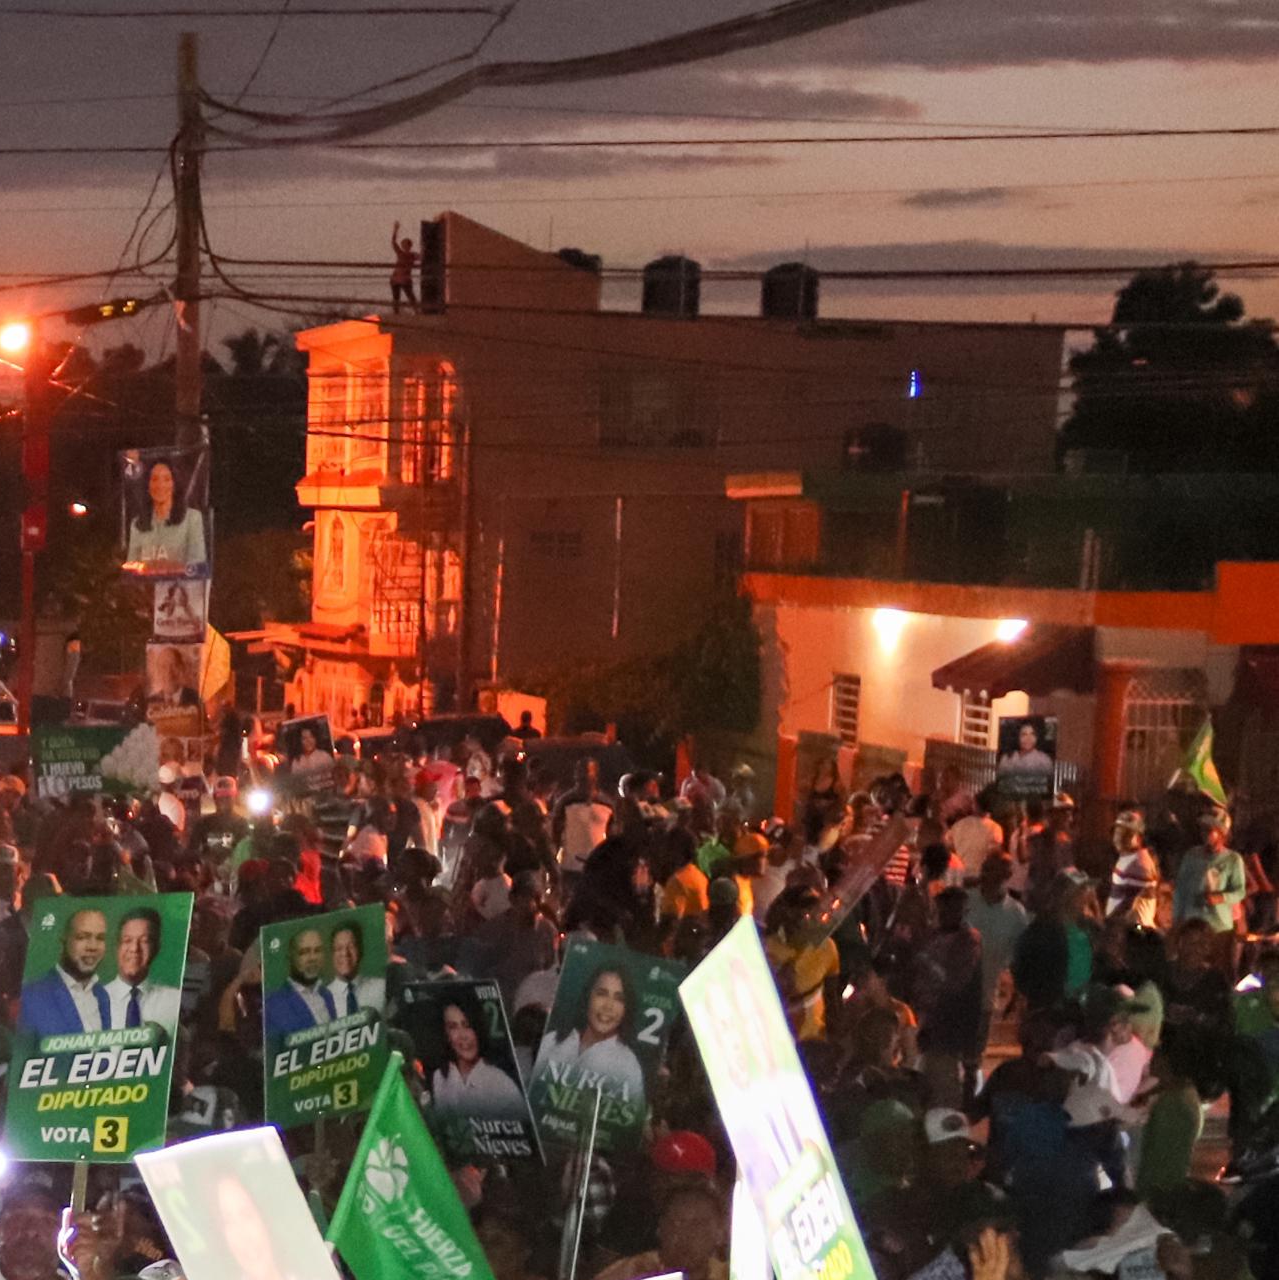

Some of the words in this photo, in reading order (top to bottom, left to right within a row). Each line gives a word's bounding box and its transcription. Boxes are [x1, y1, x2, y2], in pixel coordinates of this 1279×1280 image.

[475, 985, 498, 1000] VOTA
[290, 1027, 328, 1046] JOHAN
[330, 1012, 368, 1033] MATOS
[483, 1002, 507, 1039] 2
[637, 1006, 665, 1045] 2
[46, 1033, 94, 1051] JOHAN
[98, 1027, 151, 1046] MATOS
[273, 1052, 303, 1078] EL
[309, 1022, 380, 1068] EDEN
[19, 1057, 59, 1088] EL
[67, 1046, 167, 1084] EDEN
[289, 1053, 370, 1090] DIPUTADO
[37, 1084, 148, 1112] DIPUTADO
[294, 1095, 331, 1113] VOTA
[338, 1085, 352, 1105] 3
[41, 1126, 91, 1143] VOTA
[100, 1119, 120, 1148] 3
[469, 1116, 524, 1135] Nurca
[472, 1134, 532, 1156] Nieves
[383, 1224, 422, 1260] DEL
